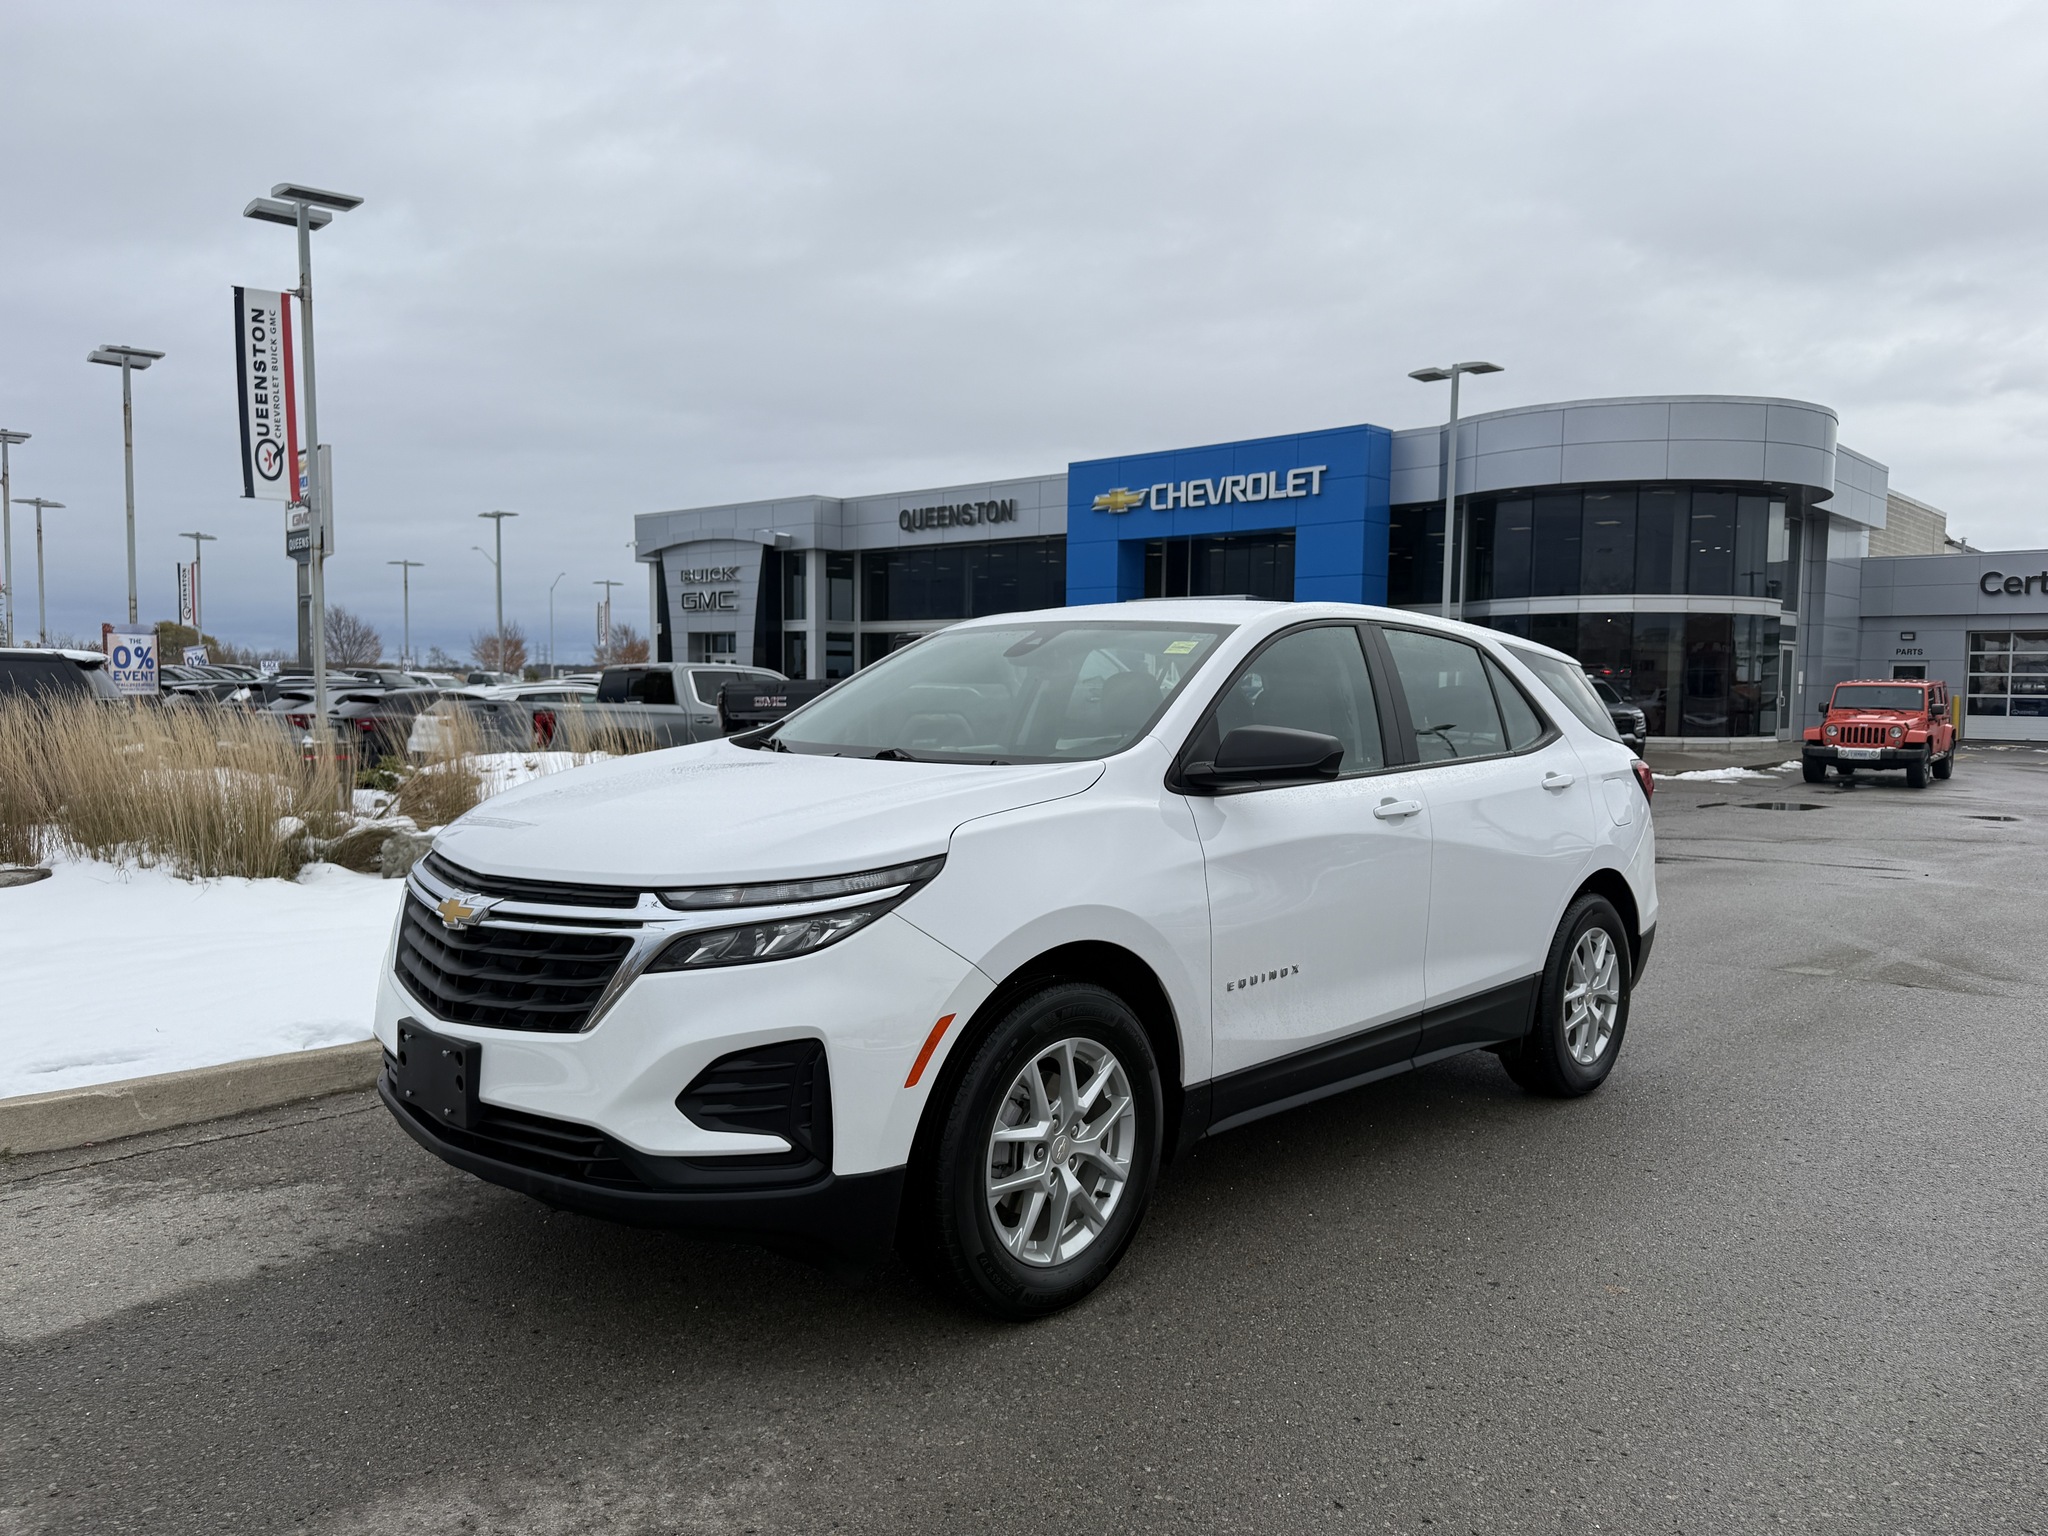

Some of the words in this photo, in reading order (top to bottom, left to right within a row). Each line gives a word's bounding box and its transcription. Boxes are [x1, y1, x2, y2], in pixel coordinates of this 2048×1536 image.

[269, 309, 277, 334] GMC
[270, 338, 279, 371] BUICK
[251, 308, 285, 481] QUEENSTON
[271, 376, 282, 439] CHEVROLET
[1150, 465, 1327, 511] CHEVROLET
[899, 499, 1017, 532] QUEENSTON
[288, 536, 310, 551] QUEENS
[681, 566, 740, 582] BUICK
[682, 591, 738, 612] GMC
[113, 646, 154, 670] 0%
[1896, 648, 1924, 656] PARTS
[113, 671, 155, 681] EVENT
[754, 696, 787, 707] GMC
[1226, 964, 1299, 992] EQUINOX
